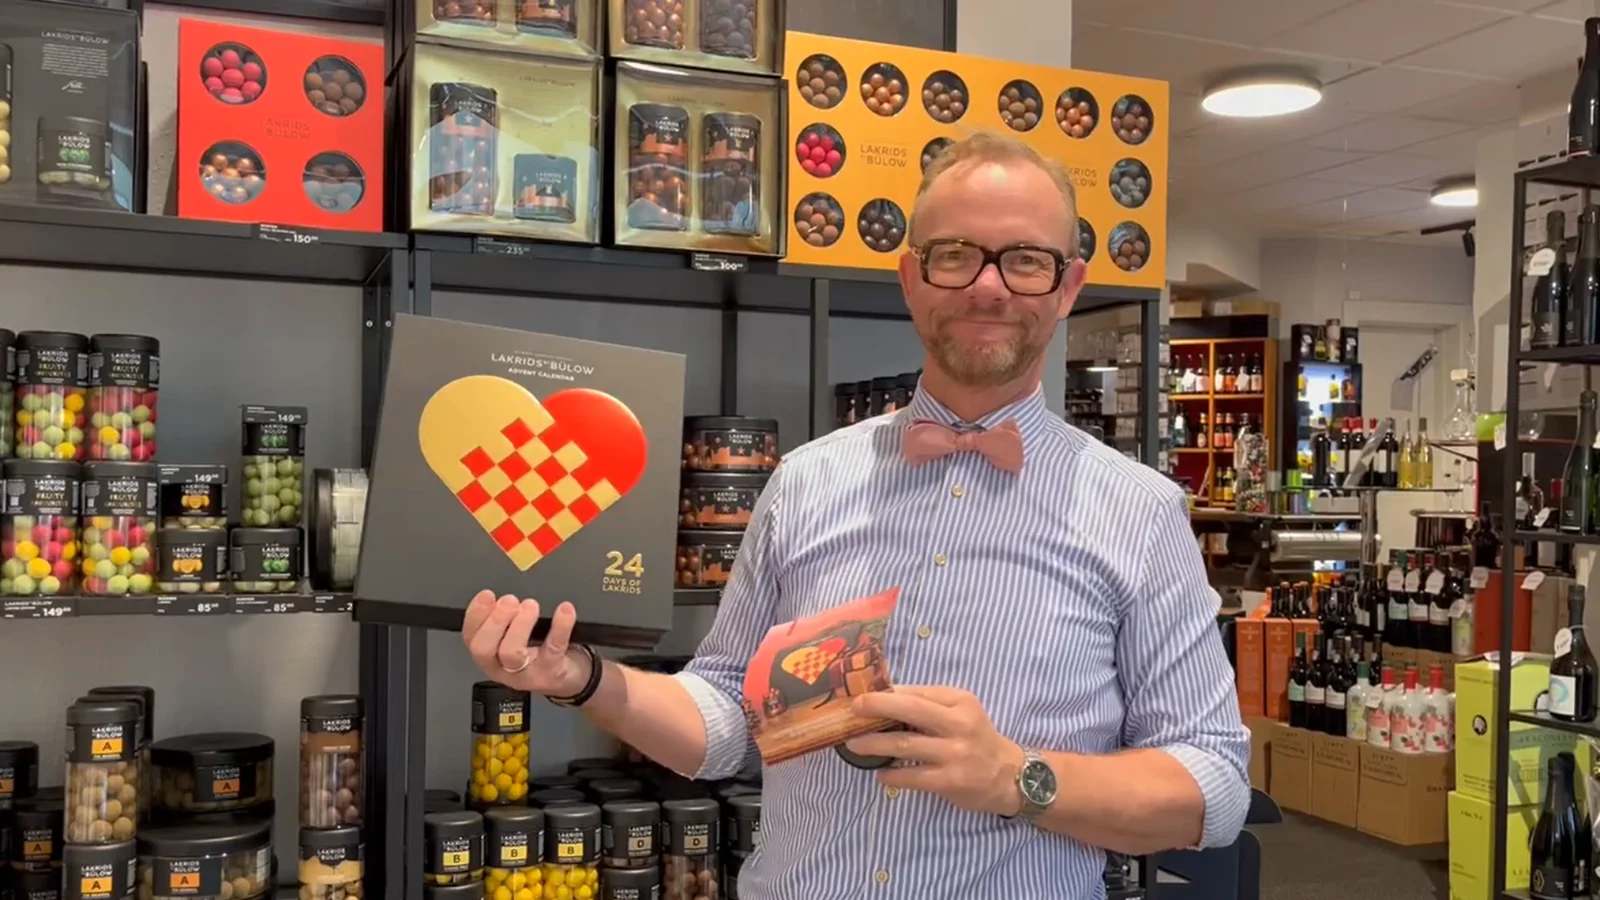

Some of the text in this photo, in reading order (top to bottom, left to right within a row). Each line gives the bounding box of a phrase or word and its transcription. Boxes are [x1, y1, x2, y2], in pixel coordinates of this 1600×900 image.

[860, 144, 907, 157] LAKRIDS
[294, 233, 311, 244] 150
[491, 353, 543, 368] LAKRIDS
[550, 360, 595, 375] BÜLOW
[508, 367, 575, 381] ADVENT CALENDAR
[278, 414, 294, 422] 149
[195, 474, 211, 482] 149
[604, 550, 645, 578] 24
[603, 577, 641, 588] DAYS OF
[602, 584, 641, 595] LAKRIDS
[43, 607, 63, 617] 149
[197, 603, 211, 612] 85
[274, 603, 287, 612] 85
[92, 725, 123, 733] LAKRIDS
[102, 741, 112, 751] A
[222, 782, 231, 790] A
[637, 840, 644, 848] D
[693, 838, 700, 846] D
[33, 843, 42, 852] A
[567, 846, 574, 854] B
[511, 849, 518, 857] B
[453, 854, 461, 863] B
[81, 864, 112, 872] LAKRIDS
[180, 875, 189, 885] A
[91, 880, 101, 890] A
